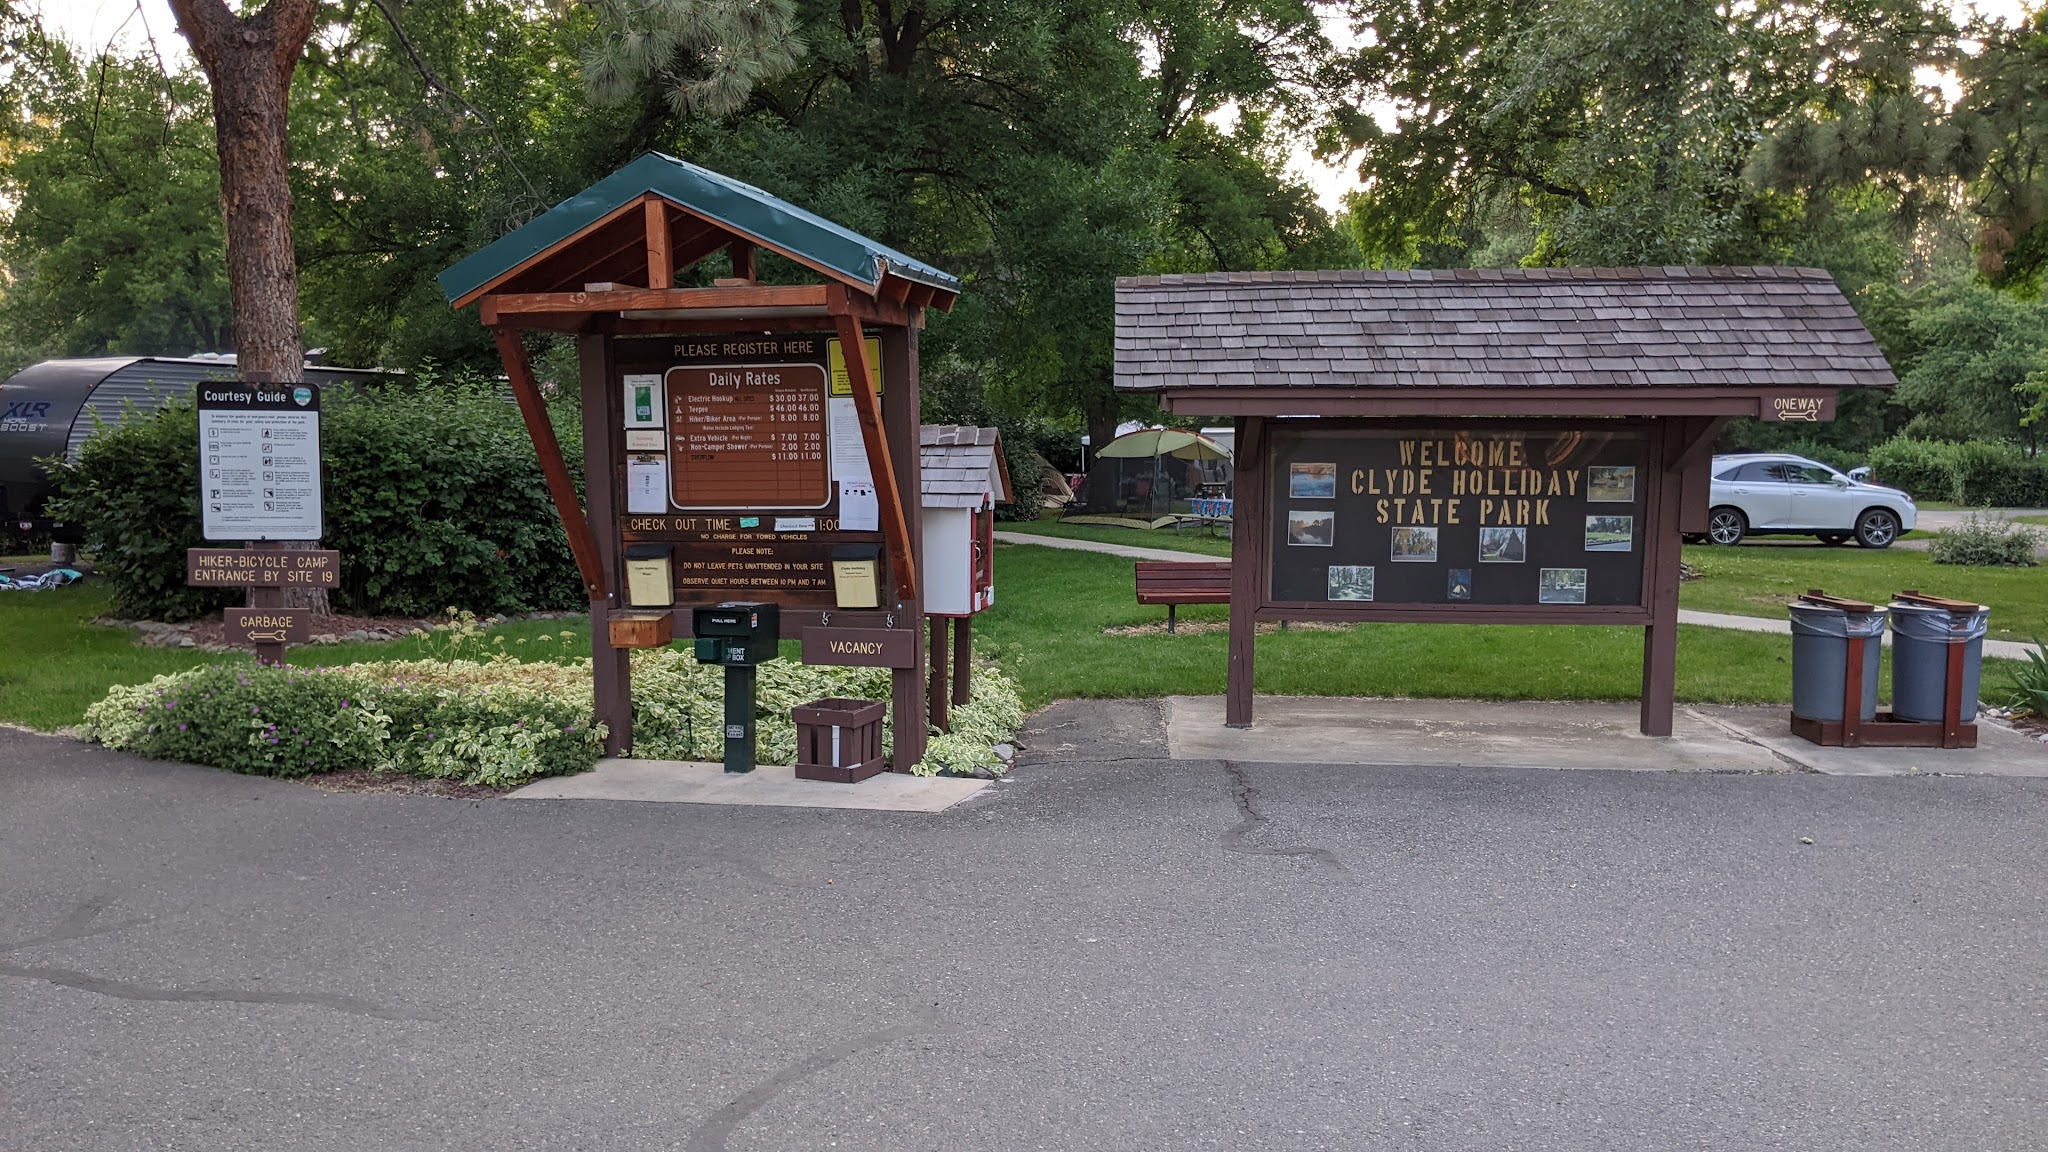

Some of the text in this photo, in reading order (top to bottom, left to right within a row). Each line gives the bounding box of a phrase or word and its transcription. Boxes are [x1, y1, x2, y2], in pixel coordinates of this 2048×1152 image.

[674, 341, 814, 356] PLEASE REGISTER HERE
[709, 372, 781, 389] Daily Rates
[204, 390, 286, 404] Courtesy Guide
[712, 395, 733, 403] Hookup
[689, 406, 708, 414] Teepee
[1774, 398, 1824, 410] ONEWAY
[0, 402, 50, 419] XLR
[0, 423, 48, 432] BOOST
[690, 444, 725, 452] Non-Camper
[781, 443, 798, 451] 2.00
[801, 452, 821, 460] 11.00
[1399, 440, 1522, 467] WELCOME
[1351, 469, 1580, 496] CLYDE HOLLIDAY
[1376, 498, 1550, 525] STATE PARK
[631, 519, 666, 531] CHECK
[675, 519, 697, 531] OUT
[706, 519, 731, 531] TIME
[199, 556, 328, 569] HIKER-BICYCLE CAMP
[683, 562, 691, 570] DO
[693, 562, 705, 570] NOT
[707, 562, 726, 570] LEAVE
[194, 570, 333, 582] ENTRANCE BY SITE 19
[682, 578, 709, 586] OBSERVE
[711, 578, 728, 586] QUIET
[729, 578, 750, 586] HOURS
[751, 578, 779, 586] BETWEEN
[240, 617, 293, 628] GARBAGE
[830, 641, 883, 655] VACANCY
